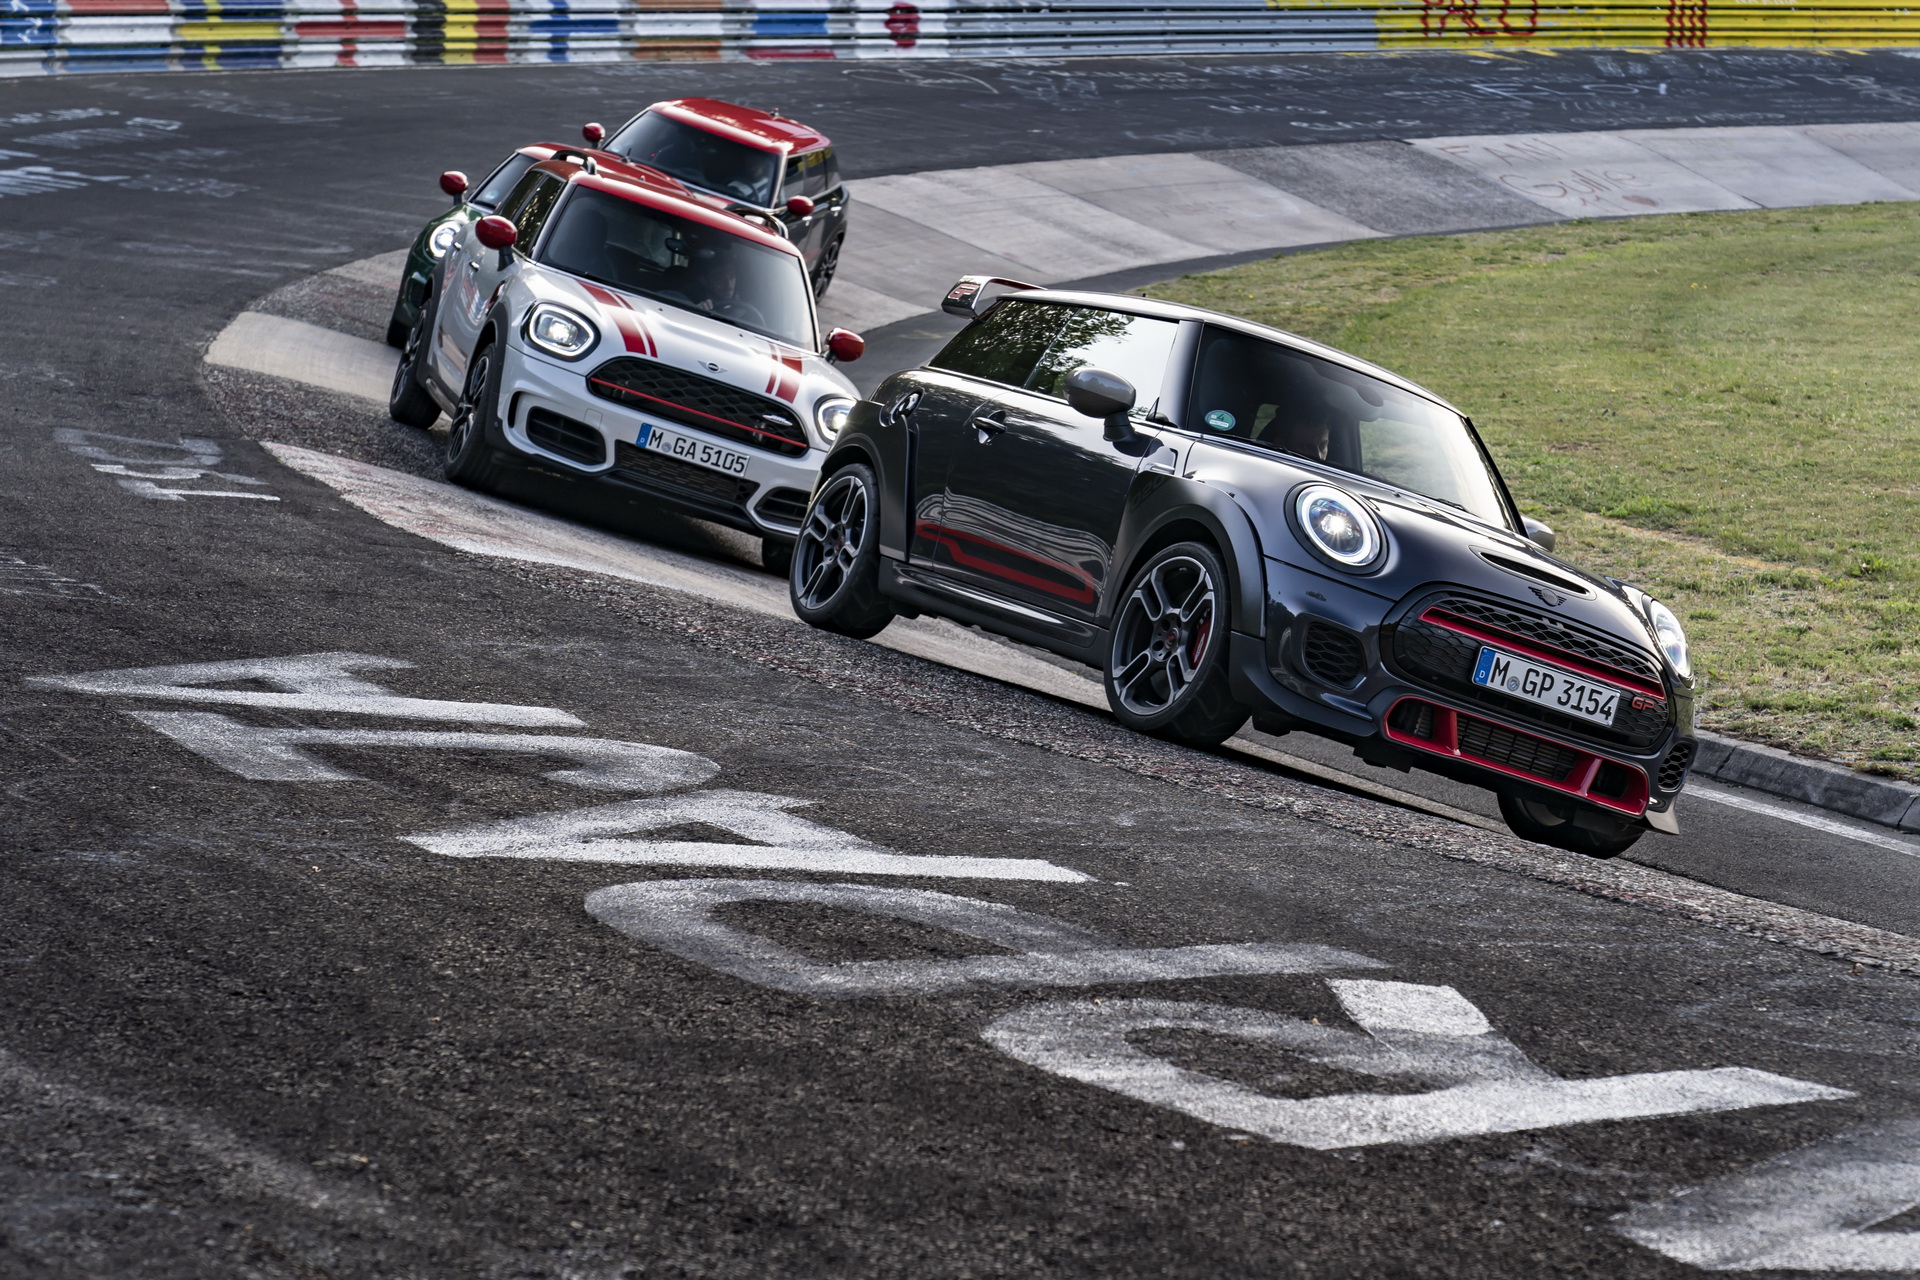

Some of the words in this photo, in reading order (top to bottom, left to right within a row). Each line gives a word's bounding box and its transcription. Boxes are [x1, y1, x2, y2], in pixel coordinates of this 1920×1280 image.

[649, 429, 664, 449] M
[673, 437, 697, 460] GA
[700, 445, 748, 474] 5105
[1478, 670, 1486, 679] D
[1490, 657, 1511, 687] M
[1522, 667, 1555, 699] GP
[1557, 679, 1617, 721] 3154
[1631, 696, 1655, 711] GP
